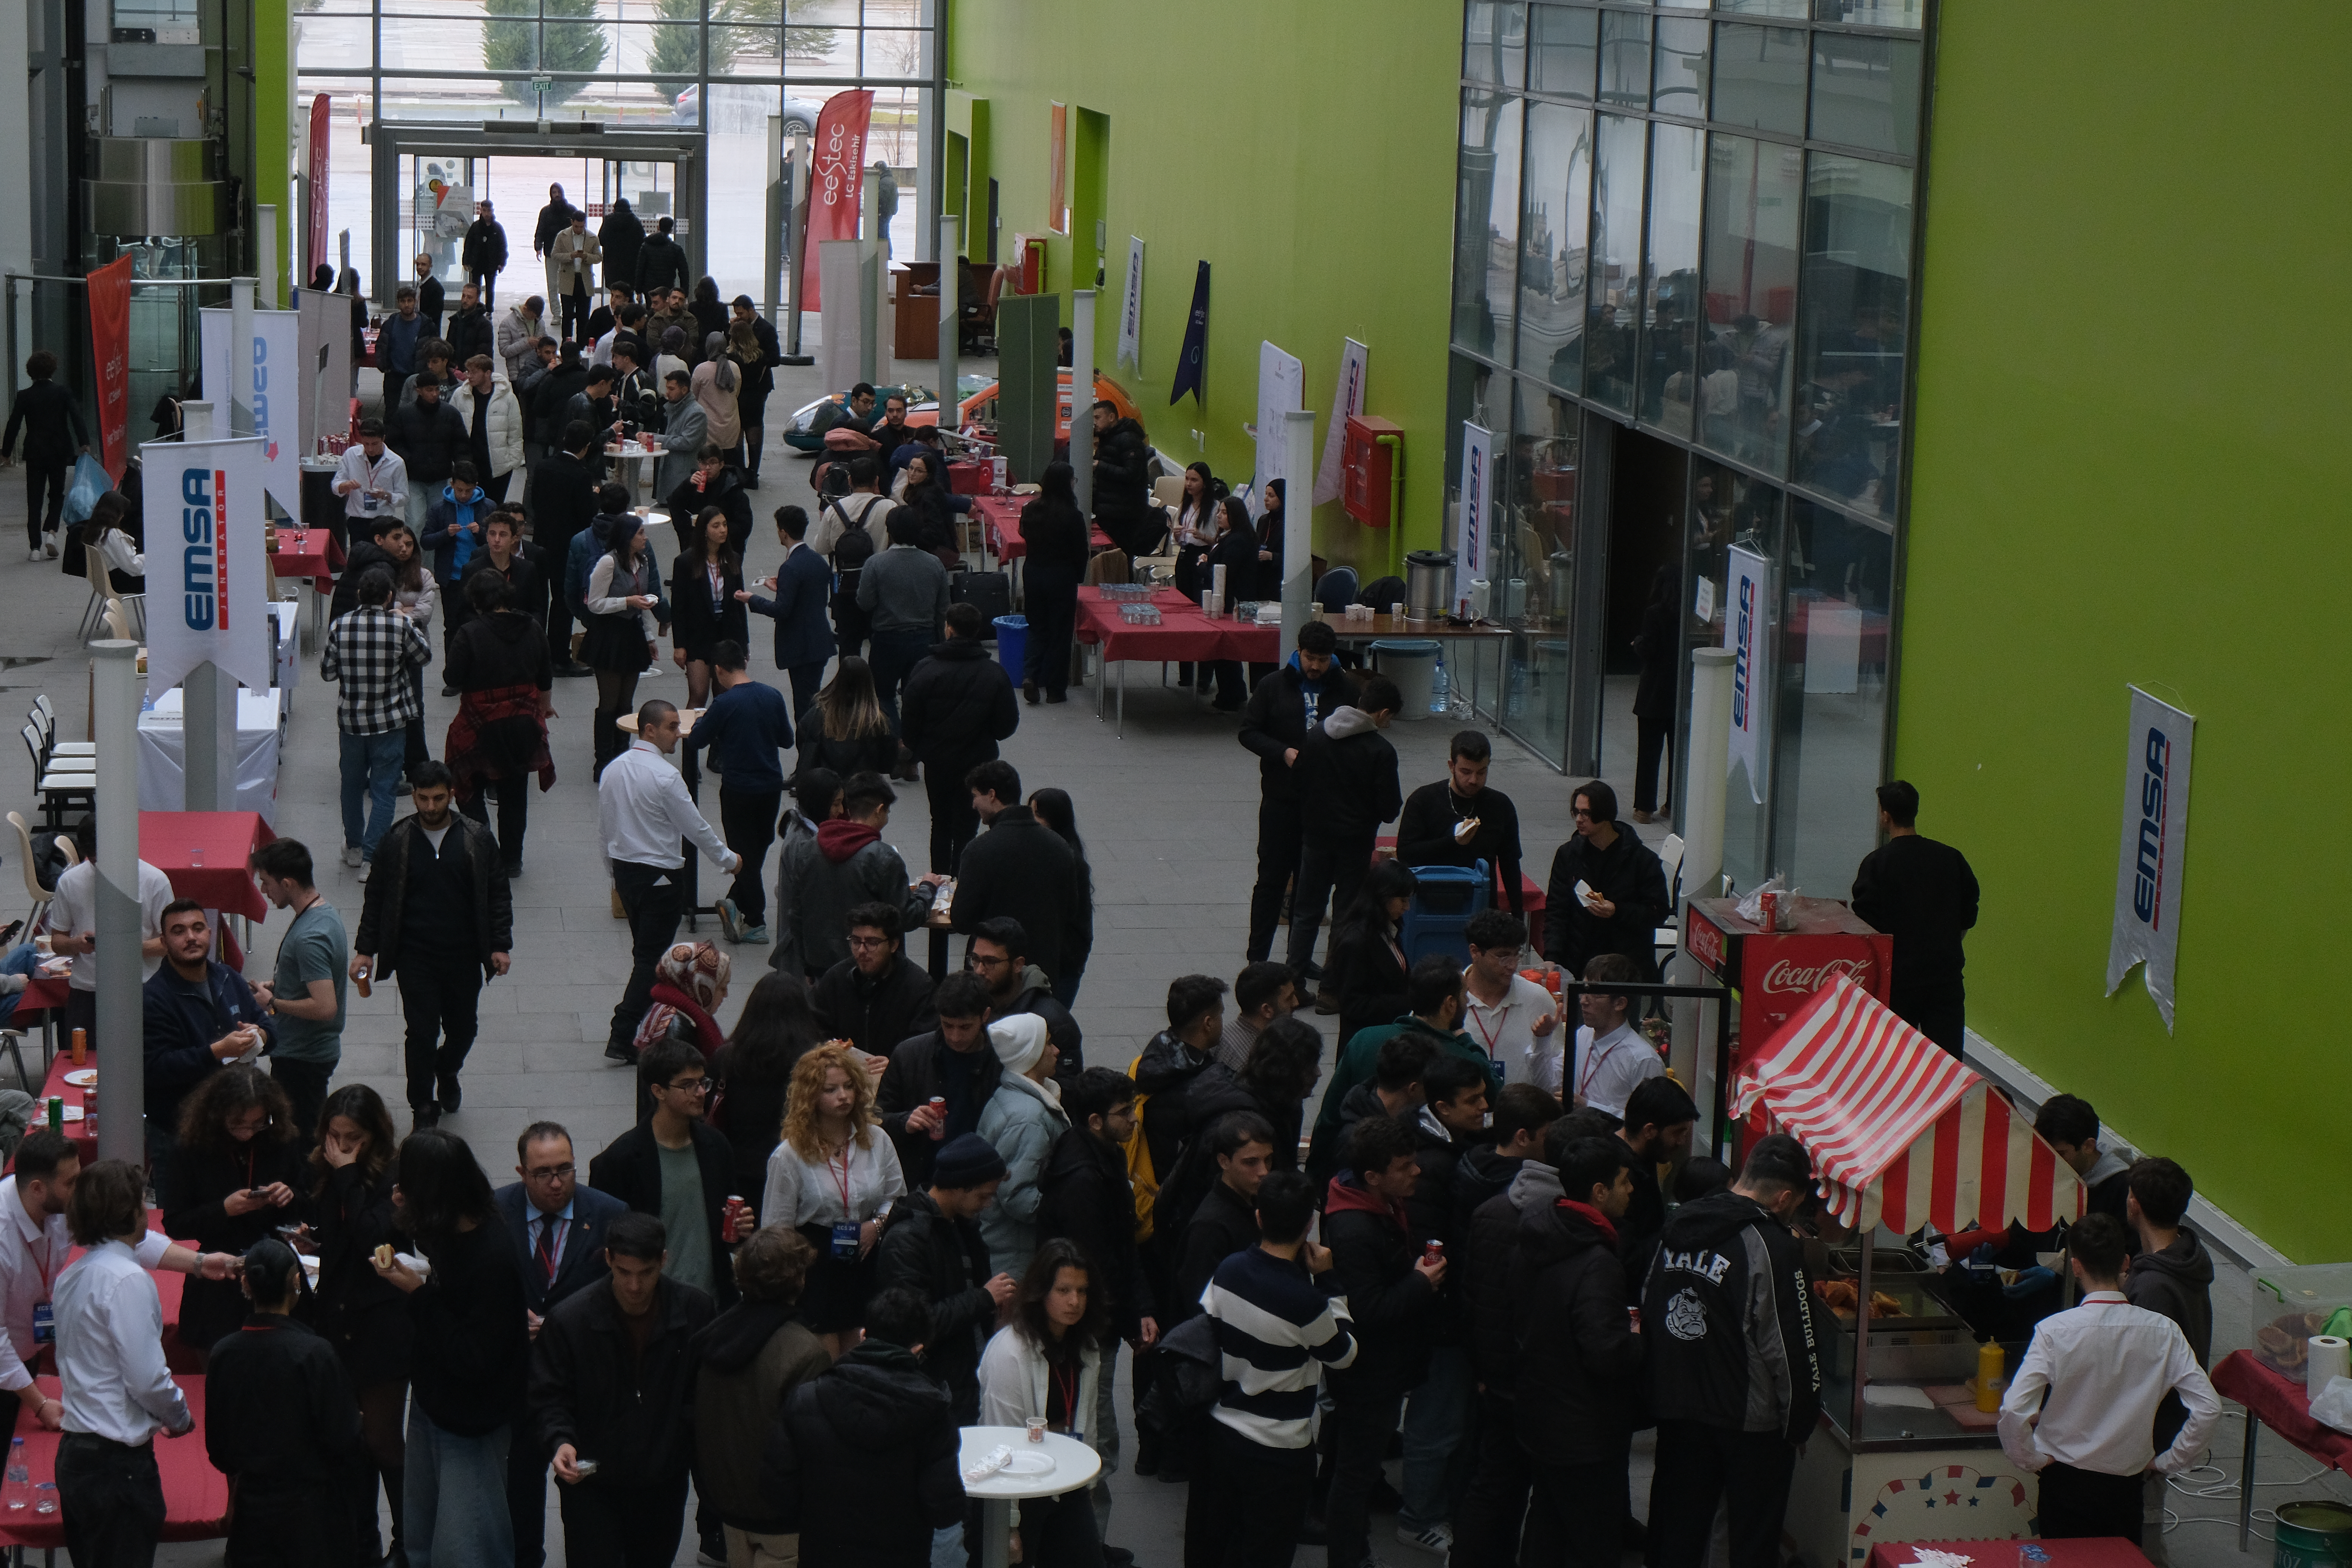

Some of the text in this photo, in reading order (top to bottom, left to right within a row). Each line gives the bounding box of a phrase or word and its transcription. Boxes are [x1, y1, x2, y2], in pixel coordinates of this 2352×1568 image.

[534, 82, 550, 90] EXIT
[845, 183, 854, 198] LC
[182, 468, 214, 631] EMSA
[1467, 444, 1479, 568] EMSA
[1733, 574, 1751, 728] EMSA
[2134, 727, 2166, 923] EMSA
[1663, 1247, 1731, 1287] YALE
[1794, 1269, 1821, 1392] YALE BULLDOGS
